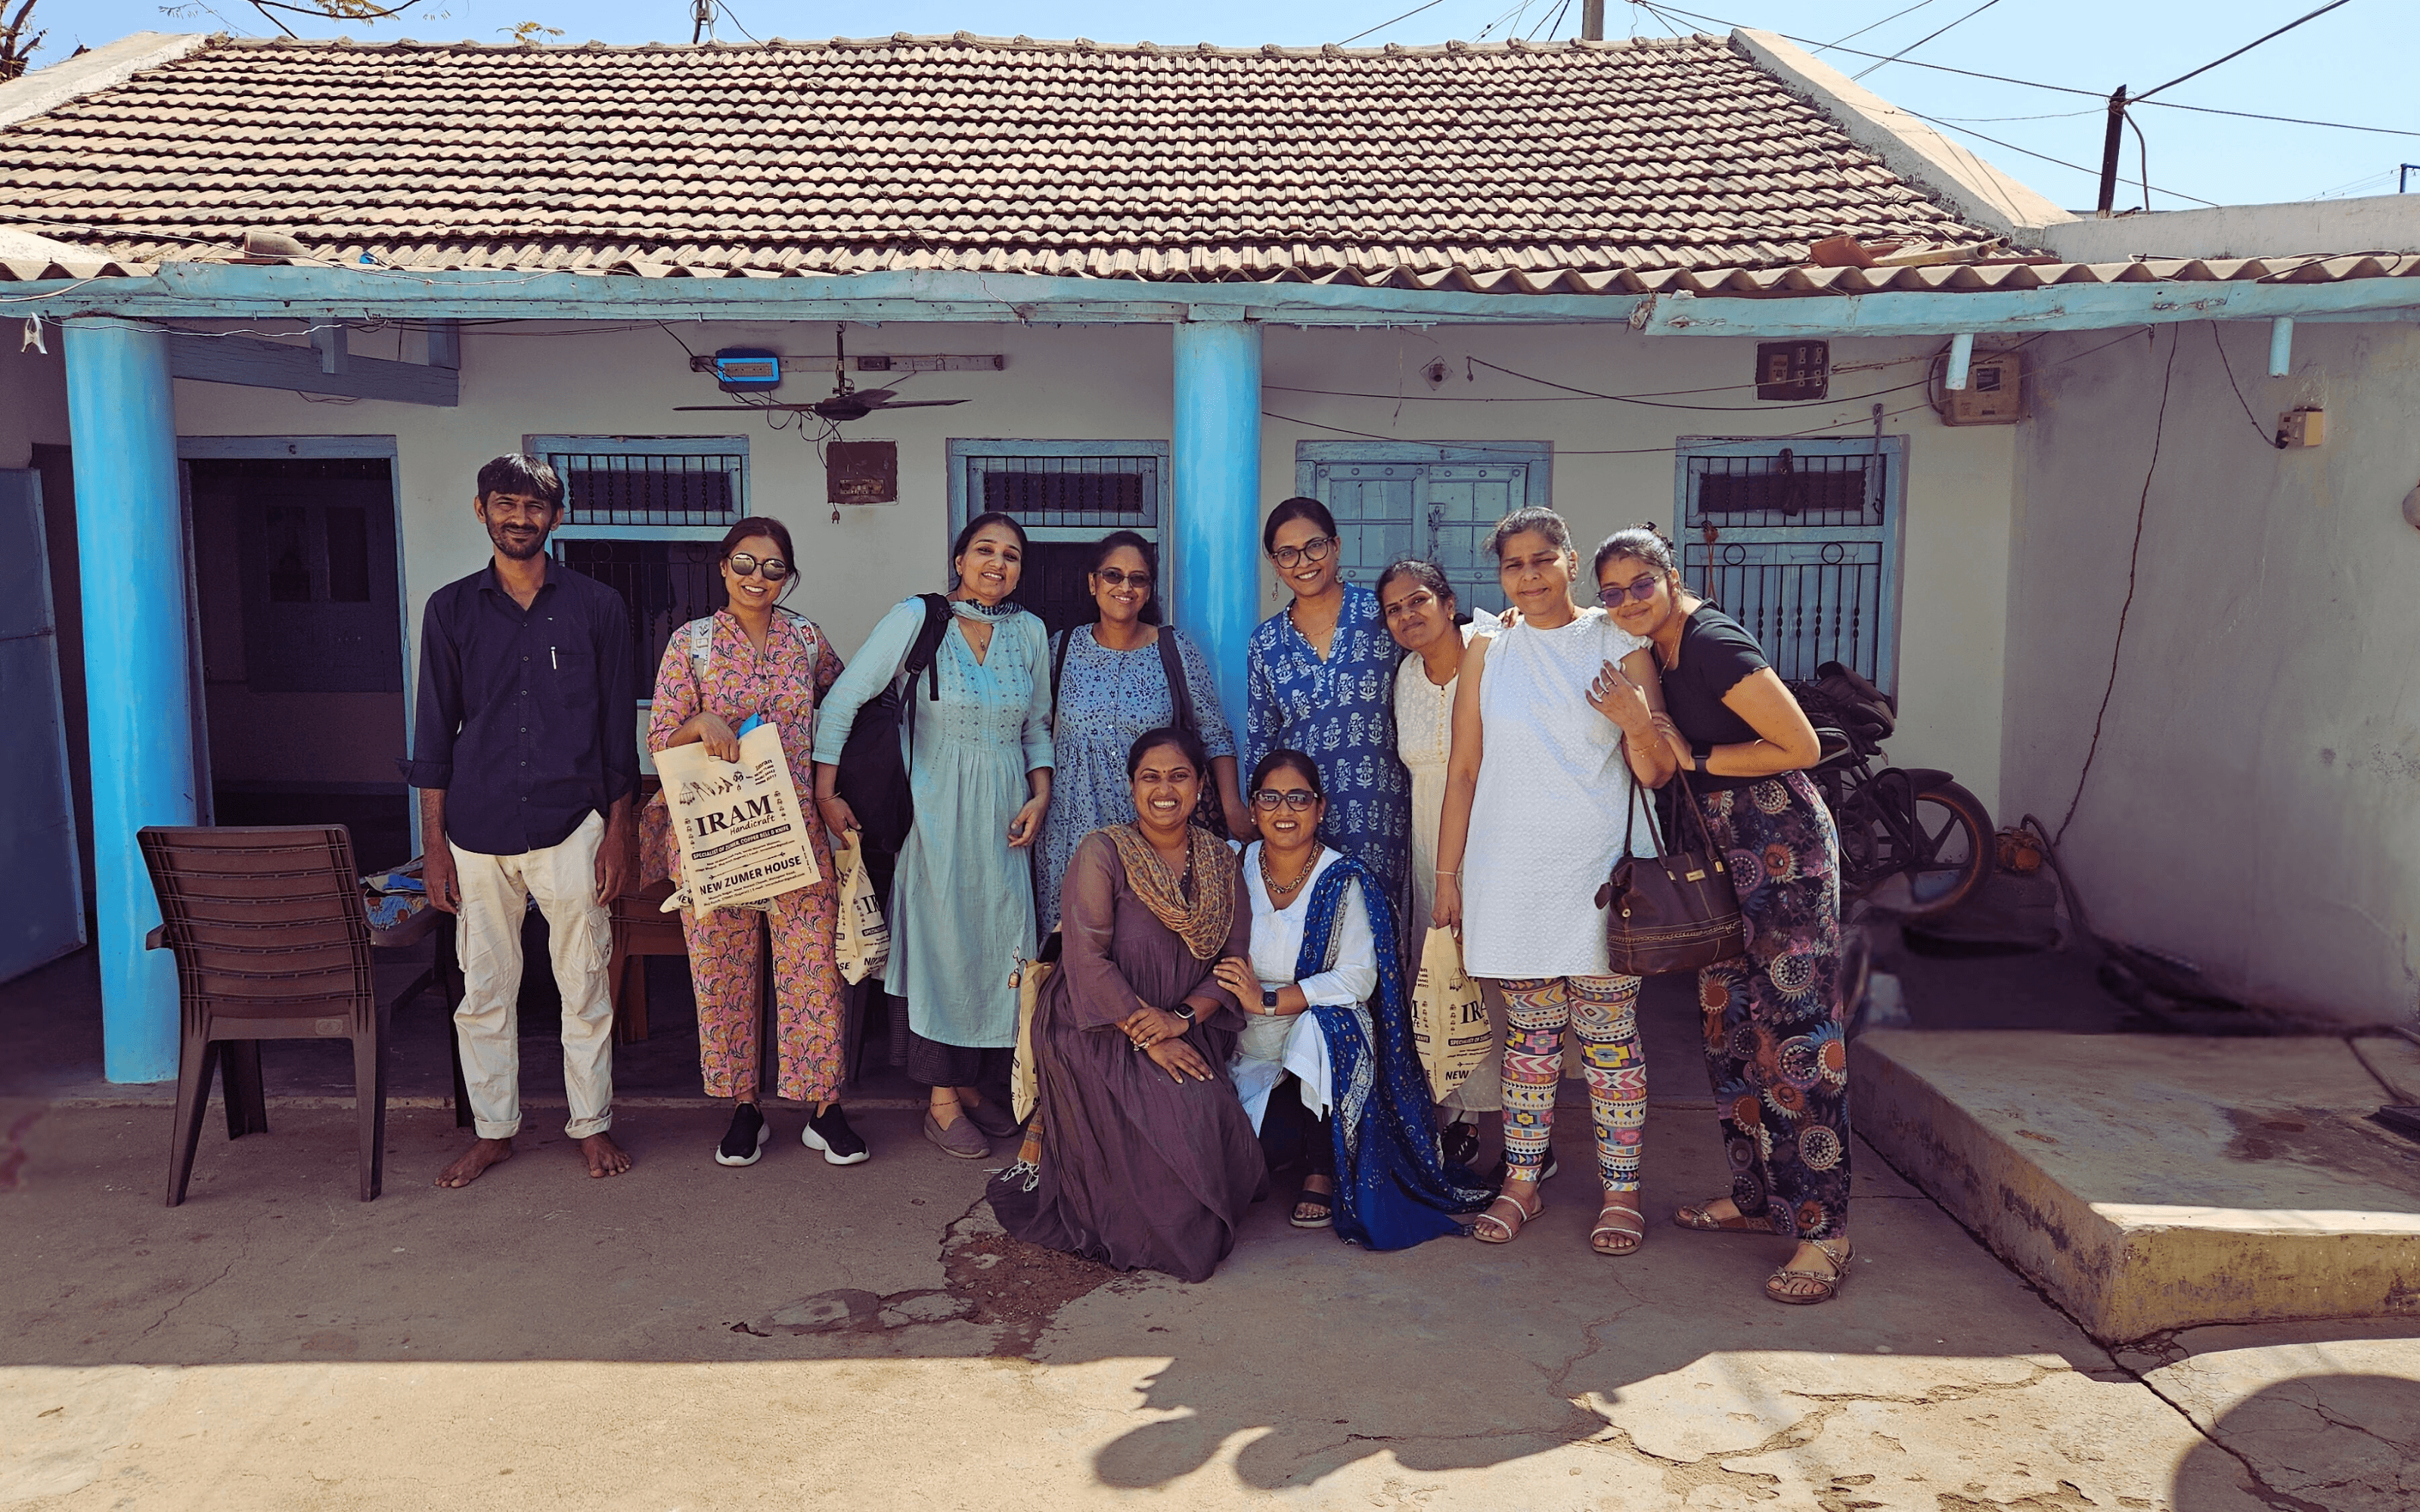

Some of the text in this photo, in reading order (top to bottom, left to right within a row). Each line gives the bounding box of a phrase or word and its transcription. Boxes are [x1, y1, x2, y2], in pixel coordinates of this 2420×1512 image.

[694, 795, 774, 837] IRAM
[730, 814, 775, 835] Handicraft
[693, 847, 718, 860] SPECIALIST
[740, 833, 759, 844] COPPER
[775, 825, 790, 833] KNIFE
[700, 880, 722, 895] NEW
[724, 867, 763, 888] ZUMER
[764, 855, 802, 875] HOUSE
[1445, 1070, 1469, 1080] NEW
